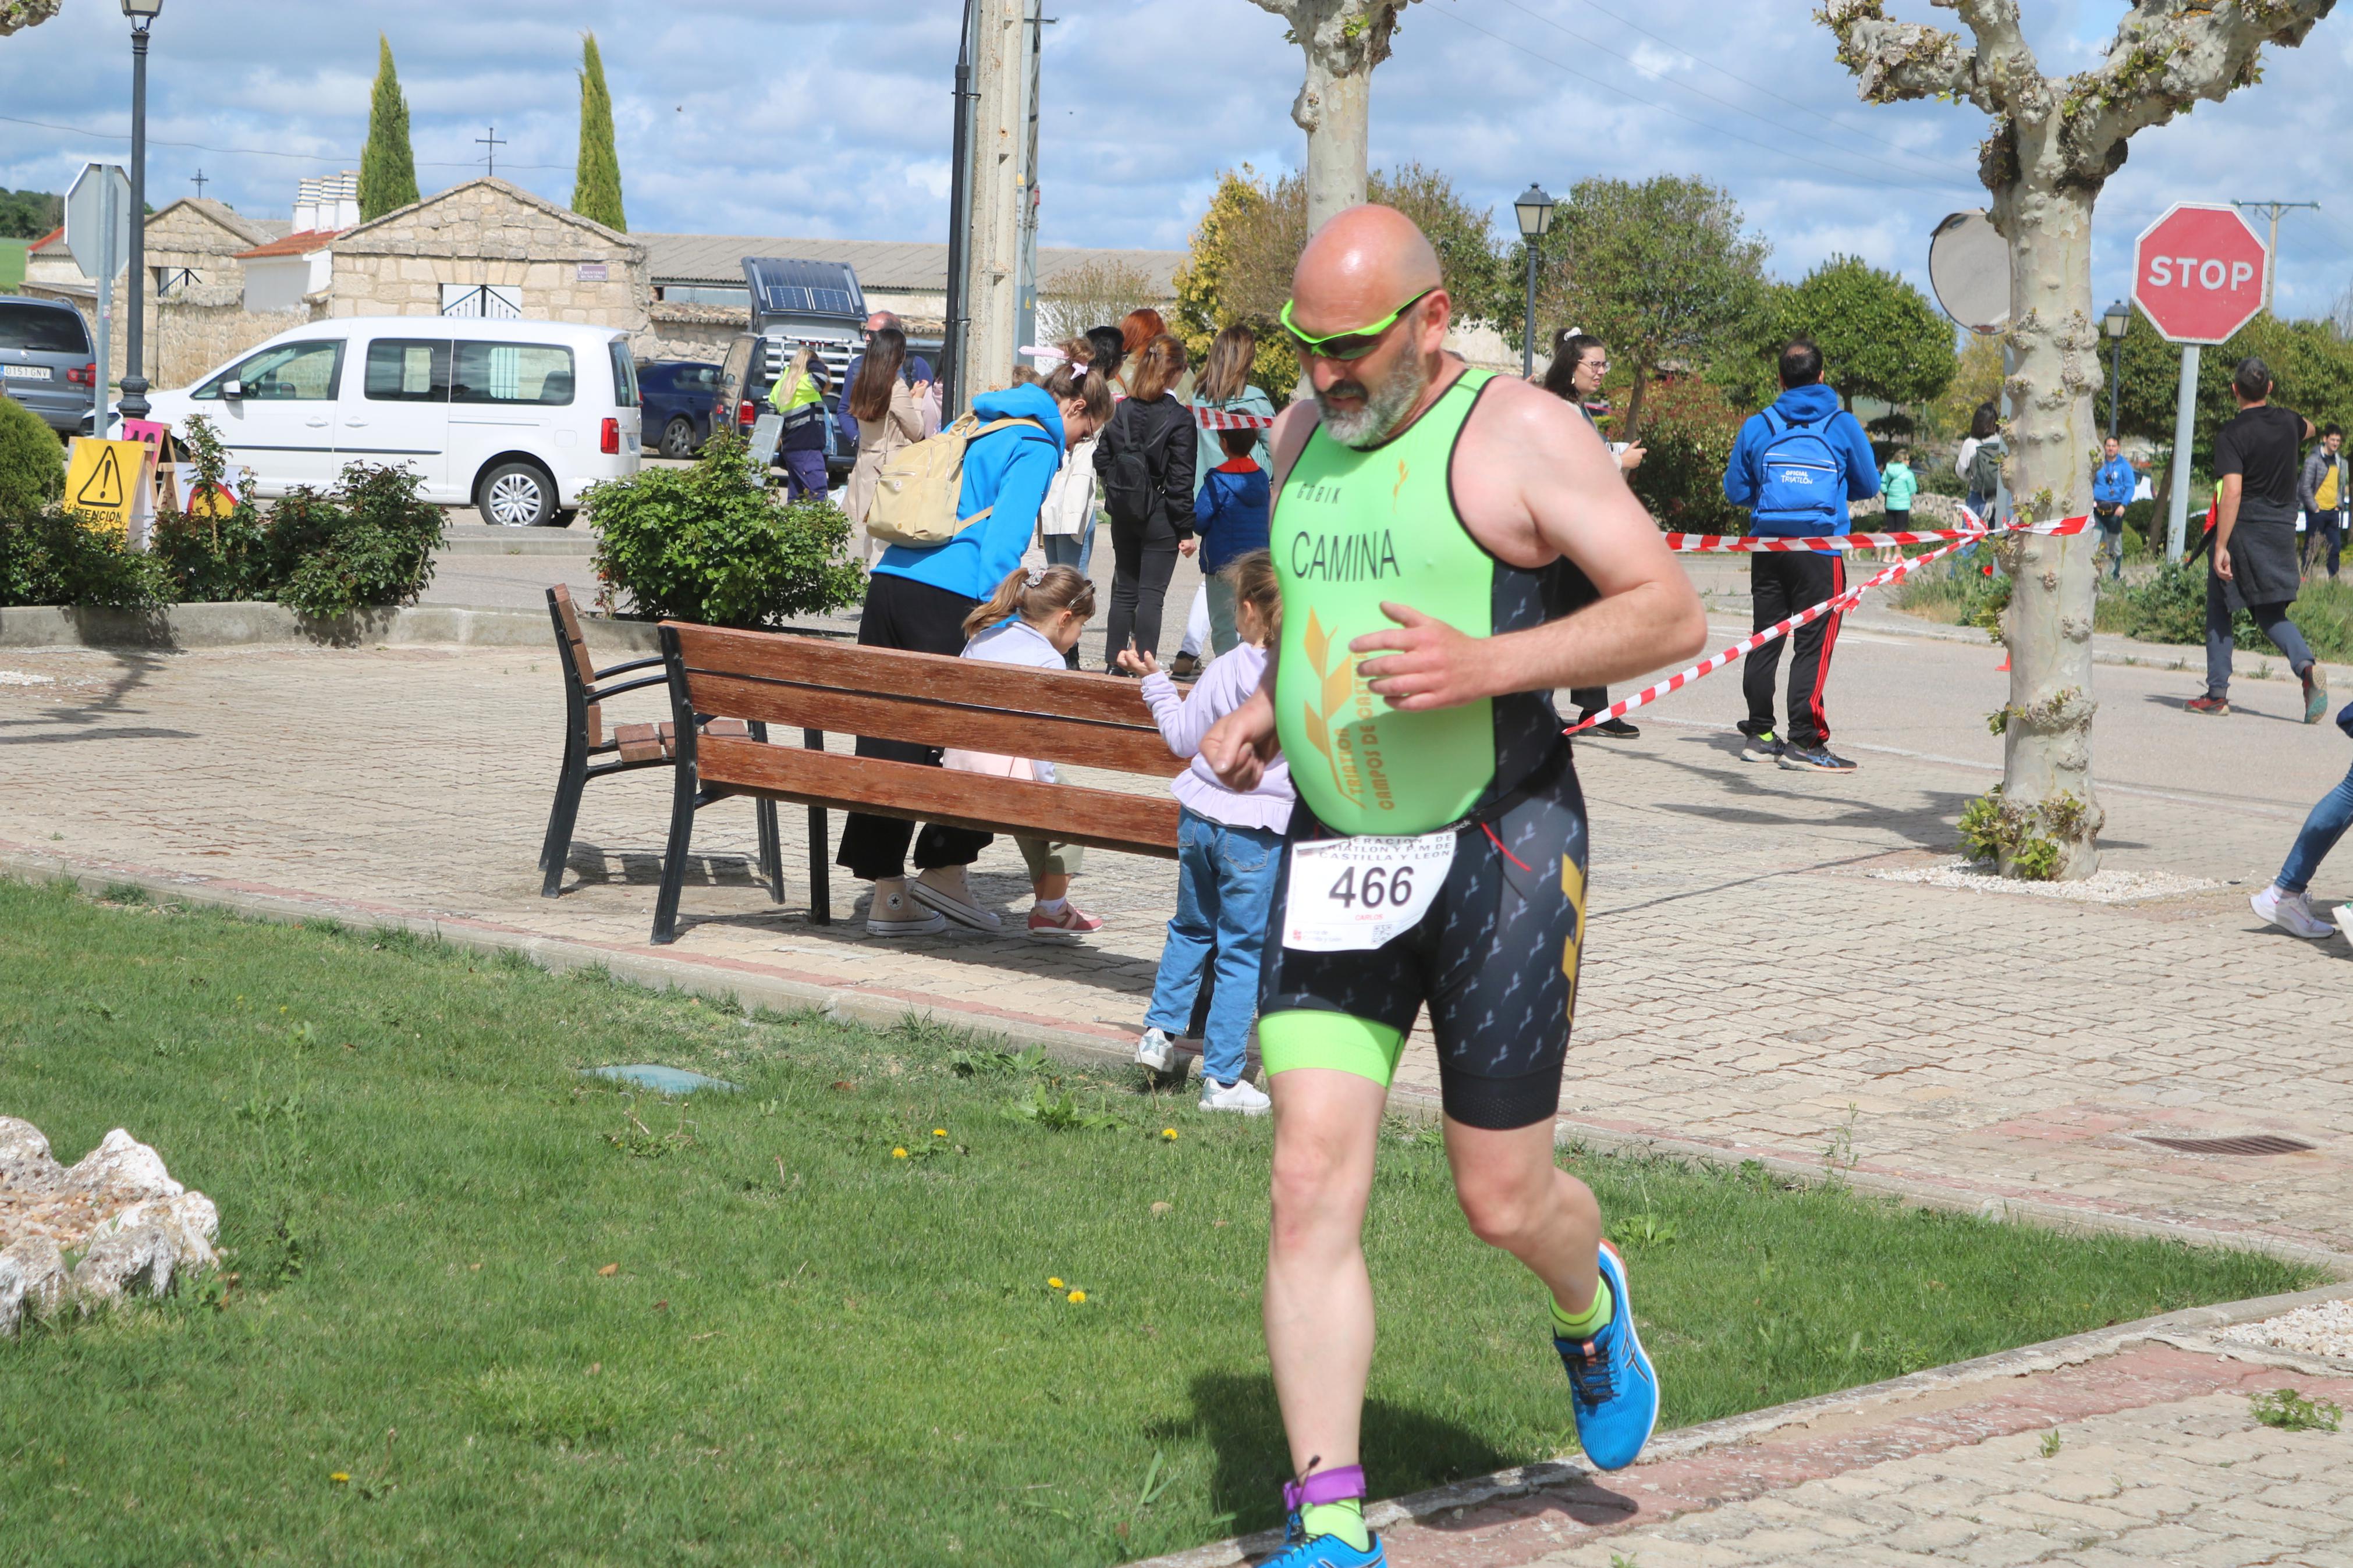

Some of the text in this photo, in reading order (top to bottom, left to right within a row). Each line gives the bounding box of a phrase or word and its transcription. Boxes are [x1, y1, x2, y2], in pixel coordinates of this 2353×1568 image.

[2148, 255, 2254, 291] STOP
[5, 367, 48, 378] 0151 GNV
[1297, 483, 1341, 504] GOBIK
[1291, 528, 1401, 582] CAMINA
[1360, 725, 1379, 745] DE
[1363, 750, 1395, 810] CAMPOS
[1435, 834, 1453, 842] DE
[1319, 851, 1392, 861] CASTILLA
[1415, 850, 1450, 860] LEON
[1328, 844, 1388, 853] RIATLON
[1329, 866, 1414, 909] 466
